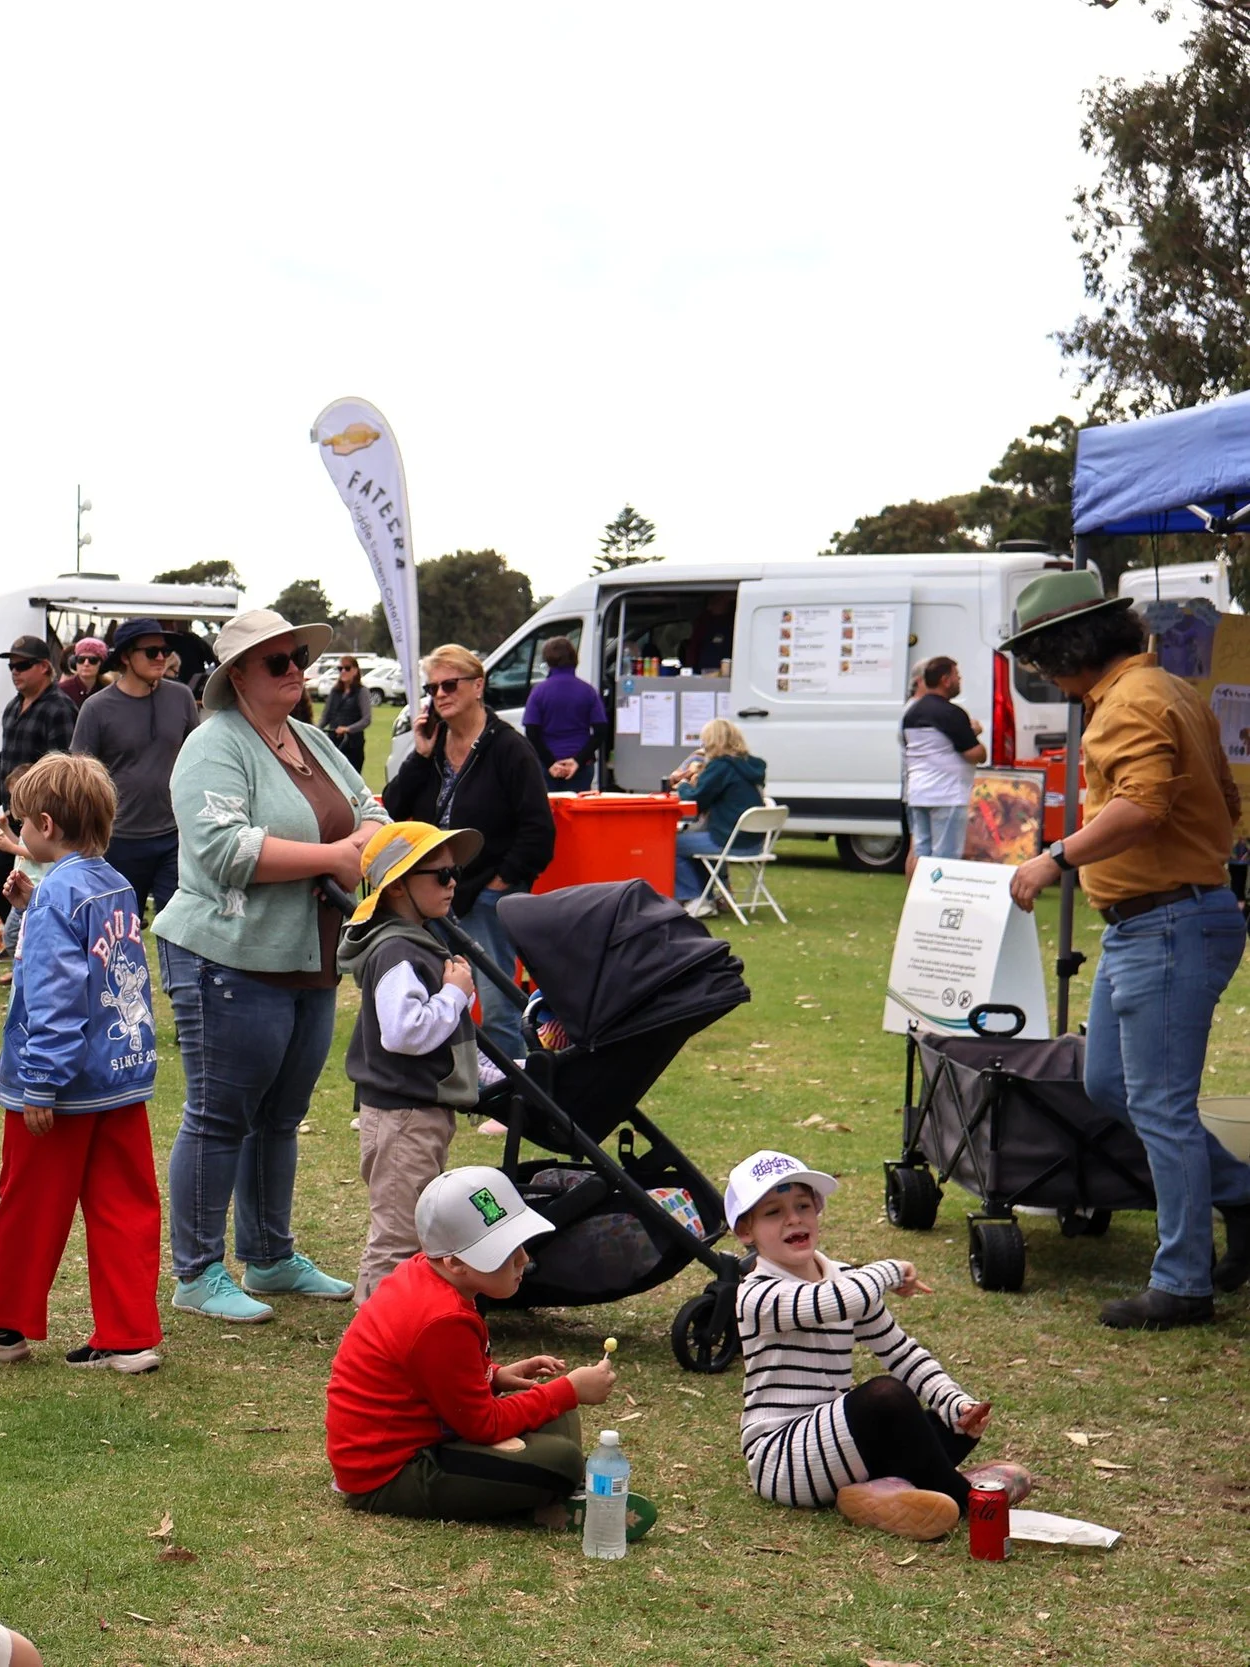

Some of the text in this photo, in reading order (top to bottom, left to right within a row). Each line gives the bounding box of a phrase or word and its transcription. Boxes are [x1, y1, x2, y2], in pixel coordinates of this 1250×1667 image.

[347, 470, 407, 571] FATEERA
[91, 909, 147, 967] BLUE
[110, 1049, 157, 1071] SINCE 20
